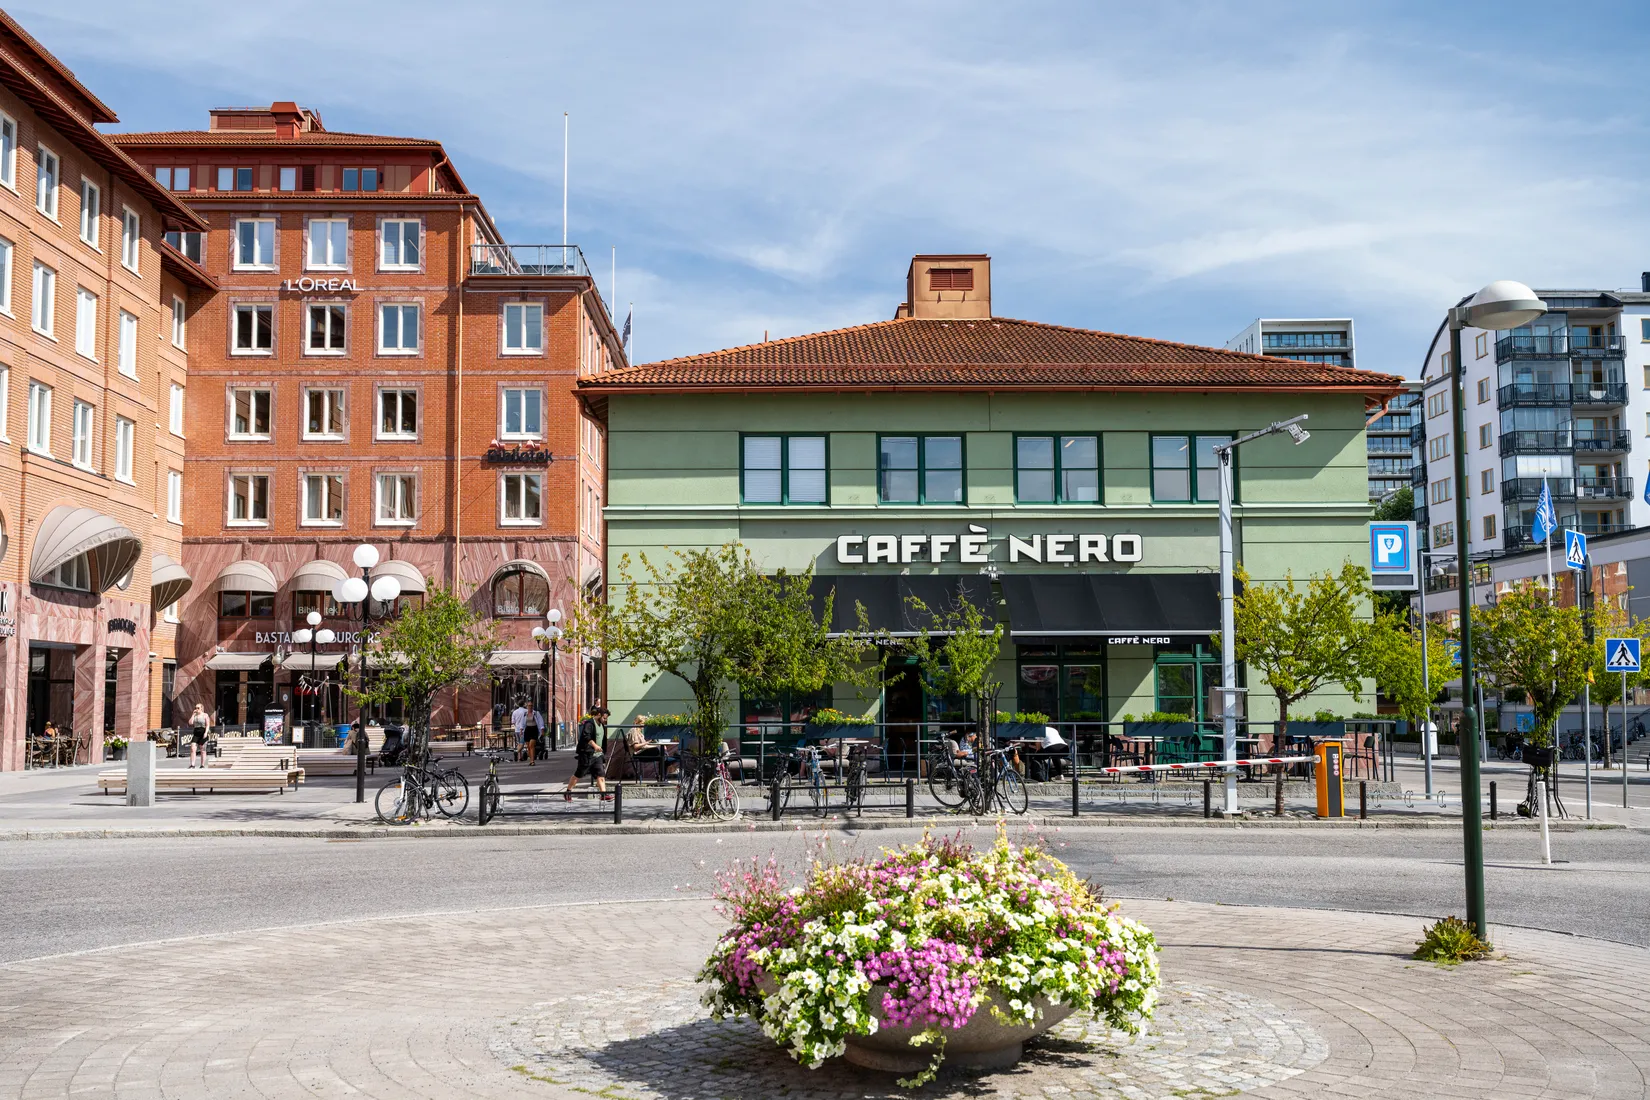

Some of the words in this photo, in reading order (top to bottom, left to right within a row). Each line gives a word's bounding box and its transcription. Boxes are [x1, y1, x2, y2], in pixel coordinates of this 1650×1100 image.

[836, 523, 989, 564] CAFFÈ
[1008, 533, 1144, 563] NERO
[1377, 534, 1402, 563] P
[255, 631, 304, 643] BASTA
[330, 631, 381, 643] URGRS
[1108, 635, 1140, 644] CAFFÈ
